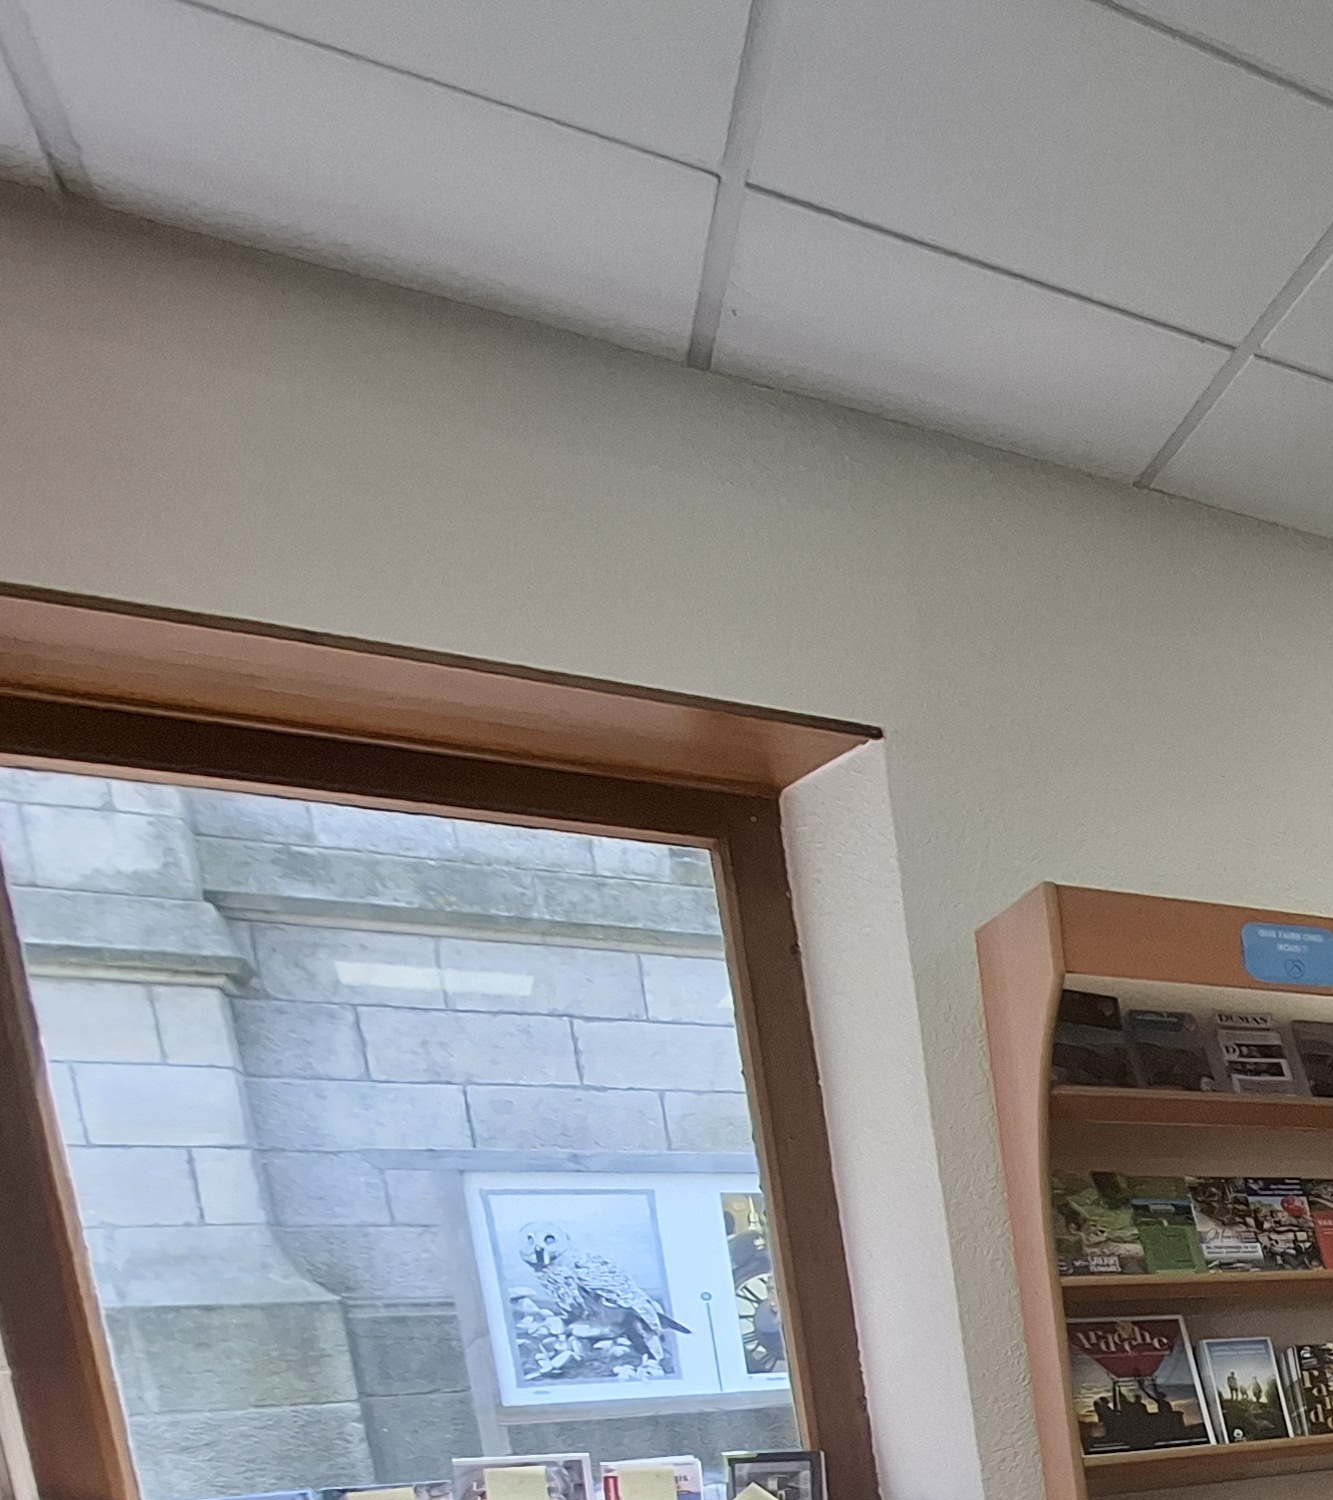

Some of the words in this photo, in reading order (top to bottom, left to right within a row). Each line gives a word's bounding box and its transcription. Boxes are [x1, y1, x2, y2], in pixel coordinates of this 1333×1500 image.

[1258, 929, 1277, 938] QUE
[1279, 930, 1301, 941] FAIRE
[1217, 1013, 1269, 1025] DUMAS
